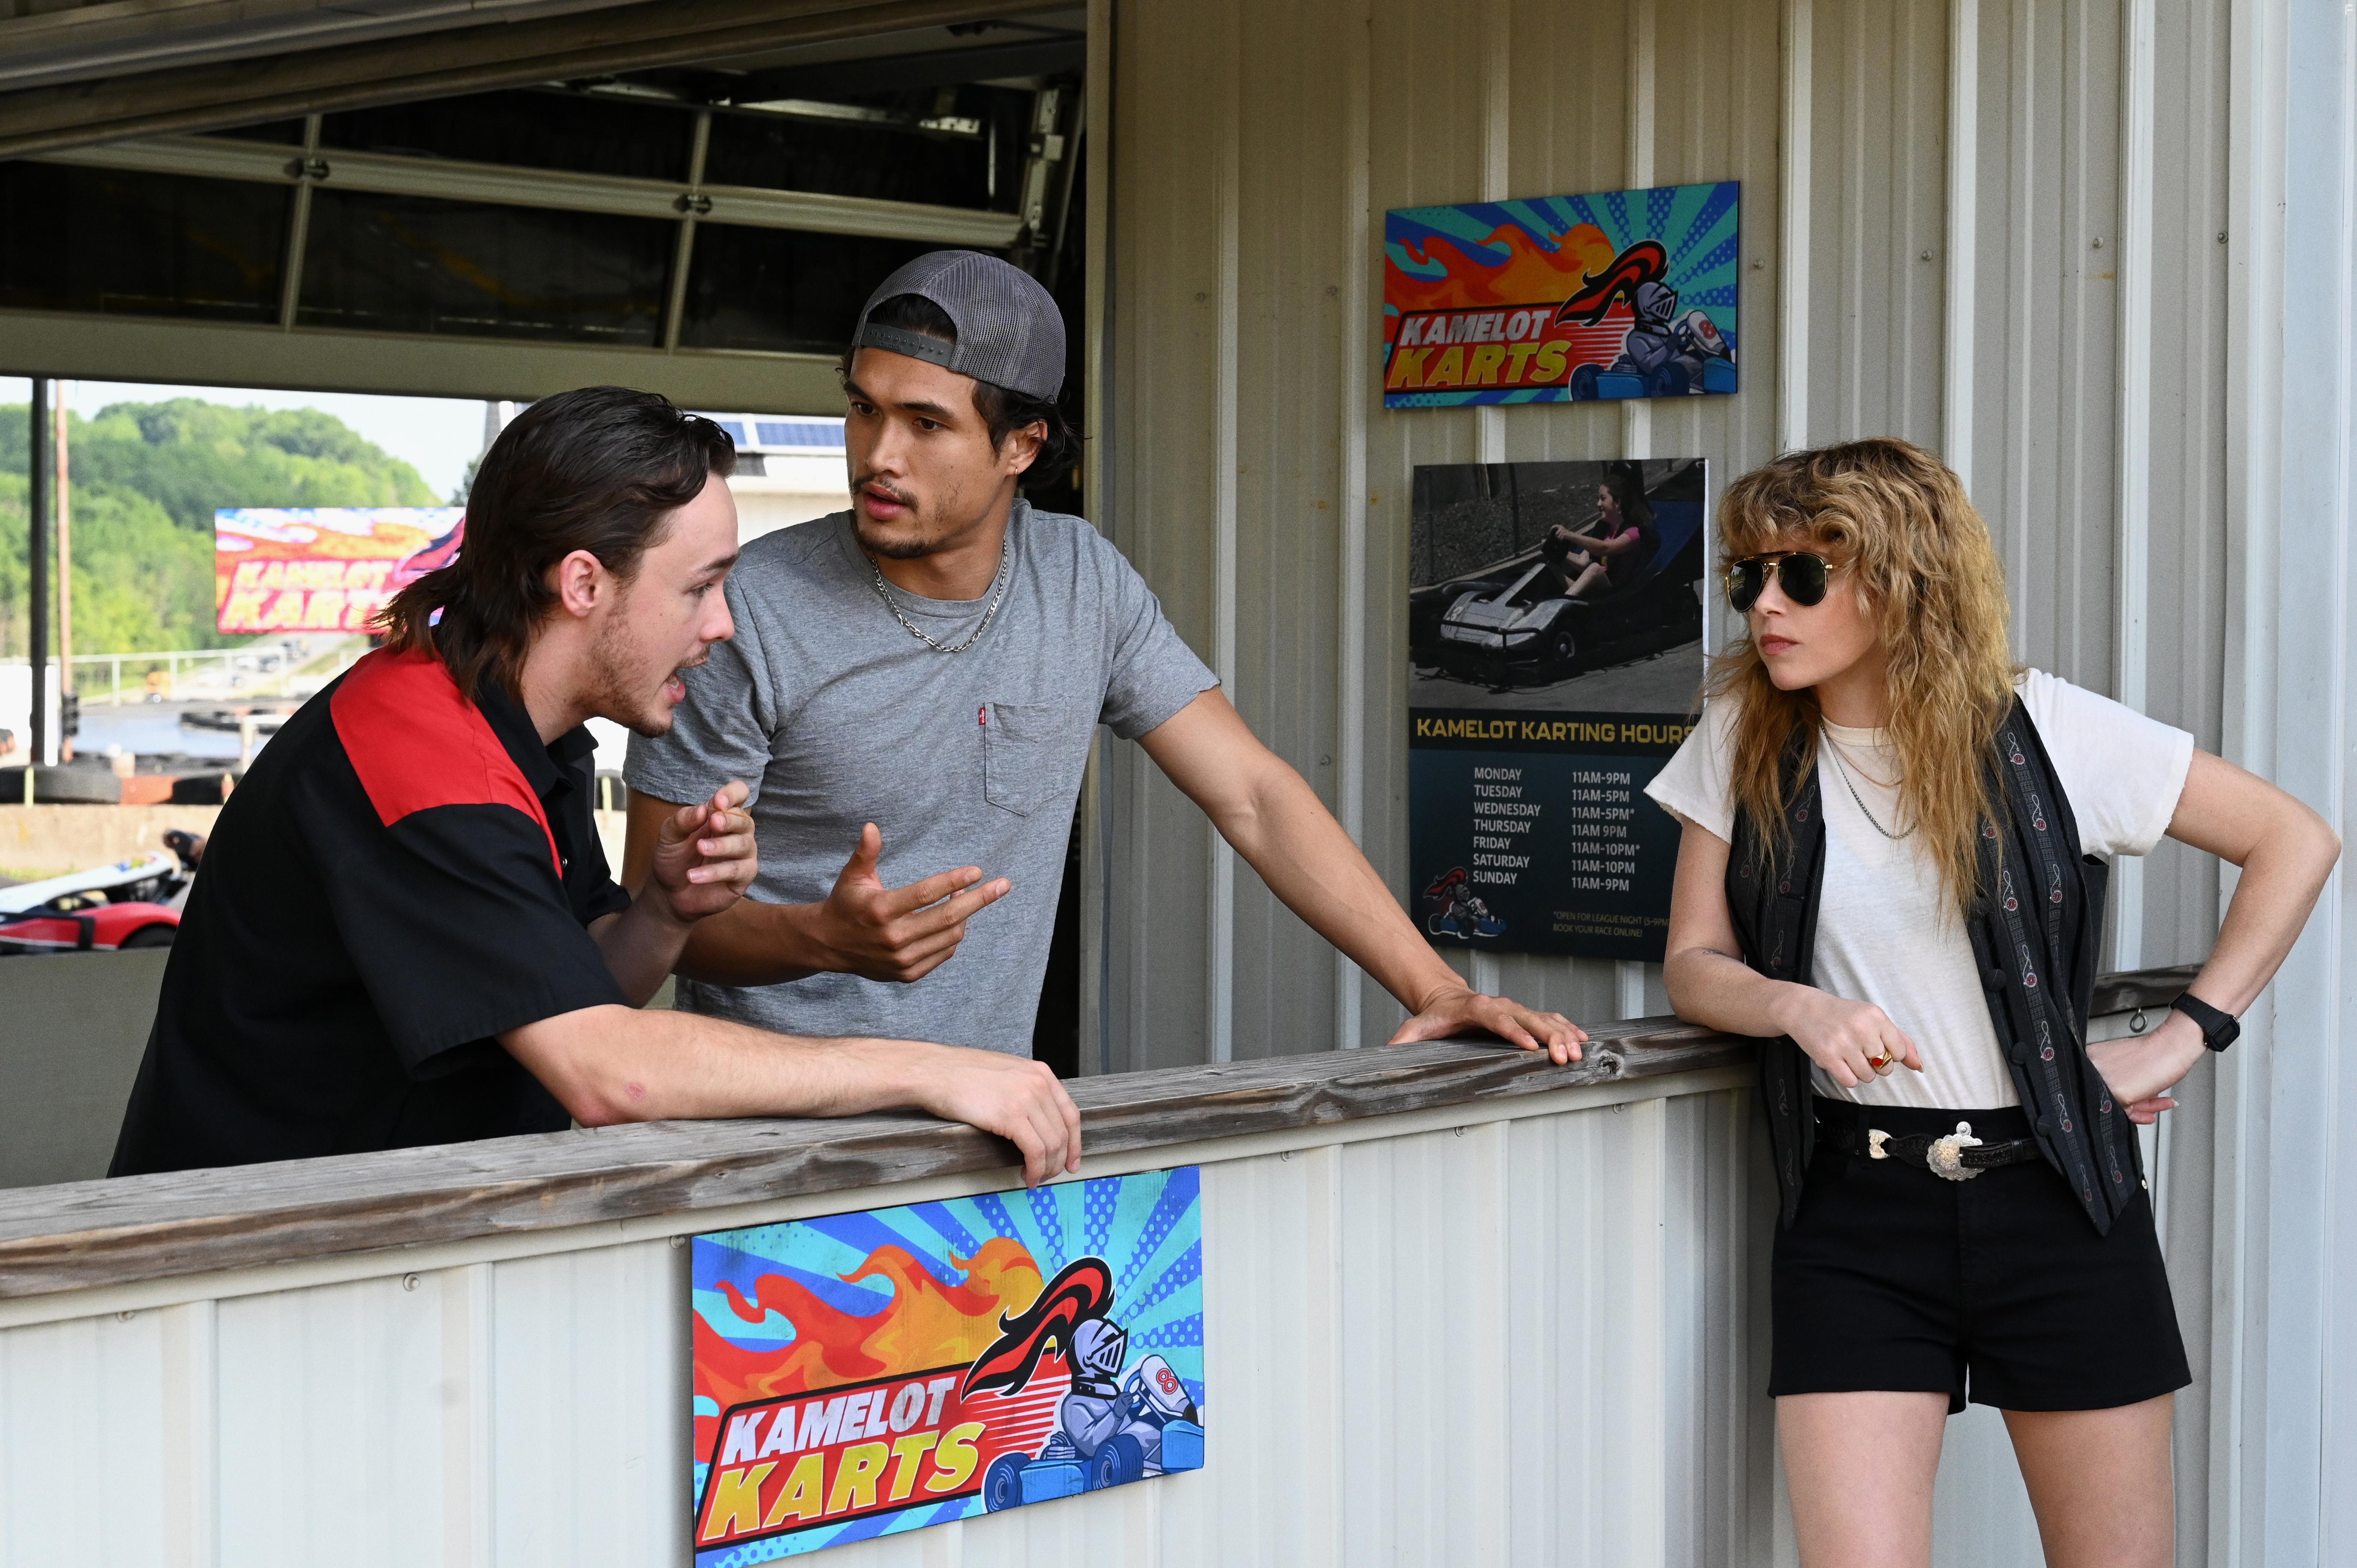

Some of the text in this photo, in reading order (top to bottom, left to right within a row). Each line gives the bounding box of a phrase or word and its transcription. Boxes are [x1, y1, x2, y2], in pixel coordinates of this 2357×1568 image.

[1399, 310, 1551, 346] KAMELOT
[1699, 320, 1716, 339] 8
[1387, 340, 1572, 388] KARTS
[219, 590, 392, 630] KART
[1417, 718, 1516, 739] KAMELOT
[1522, 721, 1615, 742] KARTING
[1474, 767, 1630, 785] MONDAY 11AM-9PM
[1474, 785, 1629, 803] TUESDAY 11AM-5PM
[1474, 802, 1540, 816] WEDNESDAY
[1473, 819, 1531, 833] THURSDAY
[1473, 836, 1511, 850] FRIDAY
[1473, 853, 1635, 874] SATURDAY 11AM-10PM
[1473, 871, 1629, 891] SUNDAY 11AM-9PM
[1577, 912, 1590, 921] FOR
[1592, 913, 1618, 923] LEAGUE
[1620, 916, 1642, 925] NIGHT
[1553, 923, 1573, 932] BOOK
[1575, 925, 1593, 934] YOUR
[1594, 926, 1611, 935] RACE
[1156, 1368, 1179, 1395] 8
[719, 1376, 956, 1466] KAMELOT
[701, 1422, 987, 1541] KARTS
